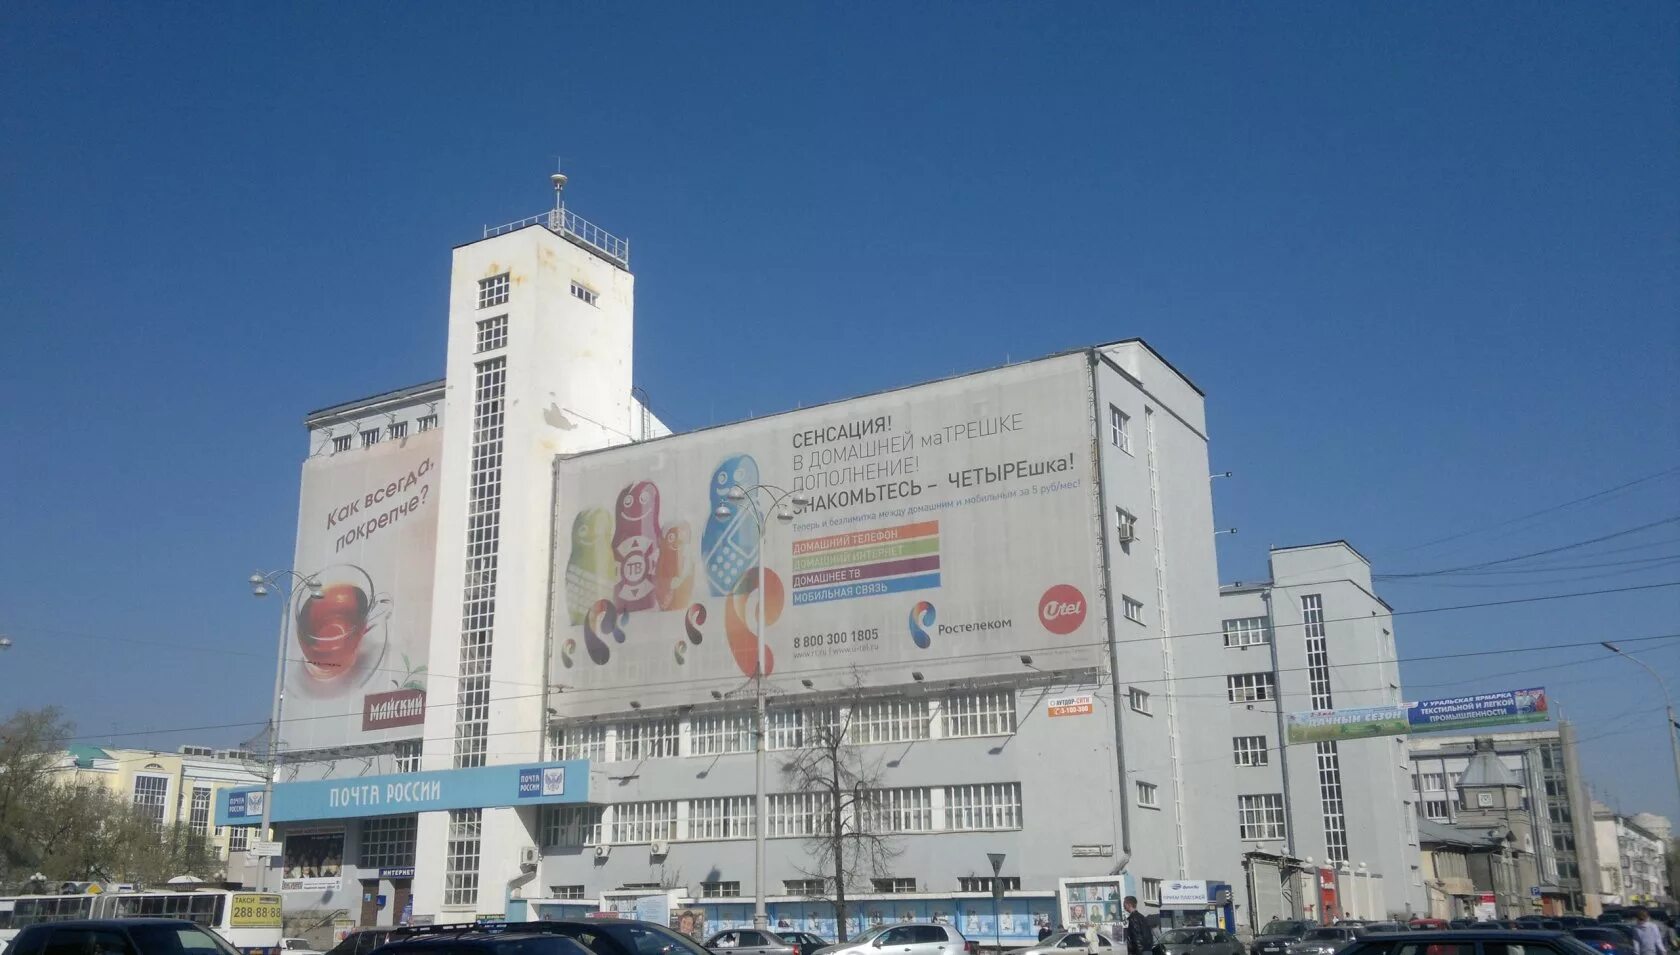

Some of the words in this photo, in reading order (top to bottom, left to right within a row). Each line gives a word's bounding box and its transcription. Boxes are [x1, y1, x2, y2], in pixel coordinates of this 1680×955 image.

[793, 415, 891, 448] СЕНСАЦИЯ!
[793, 454, 803, 471] В
[809, 430, 914, 472] ДОМАШНЕЙ
[921, 412, 1024, 448] маТРЕШКЕ
[793, 456, 919, 491] ДОПОЛНЕНИЕ!
[948, 452, 1074, 488] ЧЕТЫРЕшка!
[326, 498, 360, 530] Как
[364, 458, 434, 509] всегда,
[793, 521, 820, 533] Теперь
[830, 513, 877, 526] безлимитка
[879, 508, 905, 519] между
[908, 500, 954, 515] домашним
[956, 498, 962, 506] и
[964, 491, 1017, 504] мобильным
[1019, 488, 1030, 496] за
[1032, 485, 1038, 494] 5
[1041, 479, 1081, 494] руб/мес!
[335, 484, 430, 554] покрепче?
[793, 535, 850, 553] ДОМАШНИЙ
[853, 529, 898, 545] ТЕЛЕФОН
[793, 552, 850, 570] ДОМАШНИЙ
[851, 546, 904, 562] ИНТЕРНЕТ
[627, 562, 642, 577] ТВ
[793, 571, 847, 588] ДОМАШНЕЕ
[849, 568, 861, 578] ТВ
[793, 587, 853, 603] МОБИЛЬНАЯ
[855, 583, 888, 596] СВЯЗЬ
[1043, 600, 1082, 620] Utel
[938, 619, 1012, 636] Ростелеком
[793, 637, 800, 648] 8
[803, 634, 824, 647] 800
[826, 632, 847, 645] 300
[851, 629, 879, 642] 1805
[369, 693, 423, 722] МАЙСКИЙ
[1420, 702, 1475, 715] ТЕКСТИЛЬНОЙ
[1483, 698, 1514, 709] ЛЕГКОЙ
[1430, 696, 1474, 706] УРАЛЬСКАЯ
[1475, 692, 1512, 701] ЯРМАРКА
[1365, 711, 1401, 722] СЕЗОН
[1430, 708, 1507, 723] ПРОМЫШЛЕННОСТИ
[520, 775, 540, 783] ПОЧТА
[520, 784, 540, 792] РОССИИ
[329, 784, 379, 807] ПОЧТА
[386, 780, 441, 803] РОССИИ
